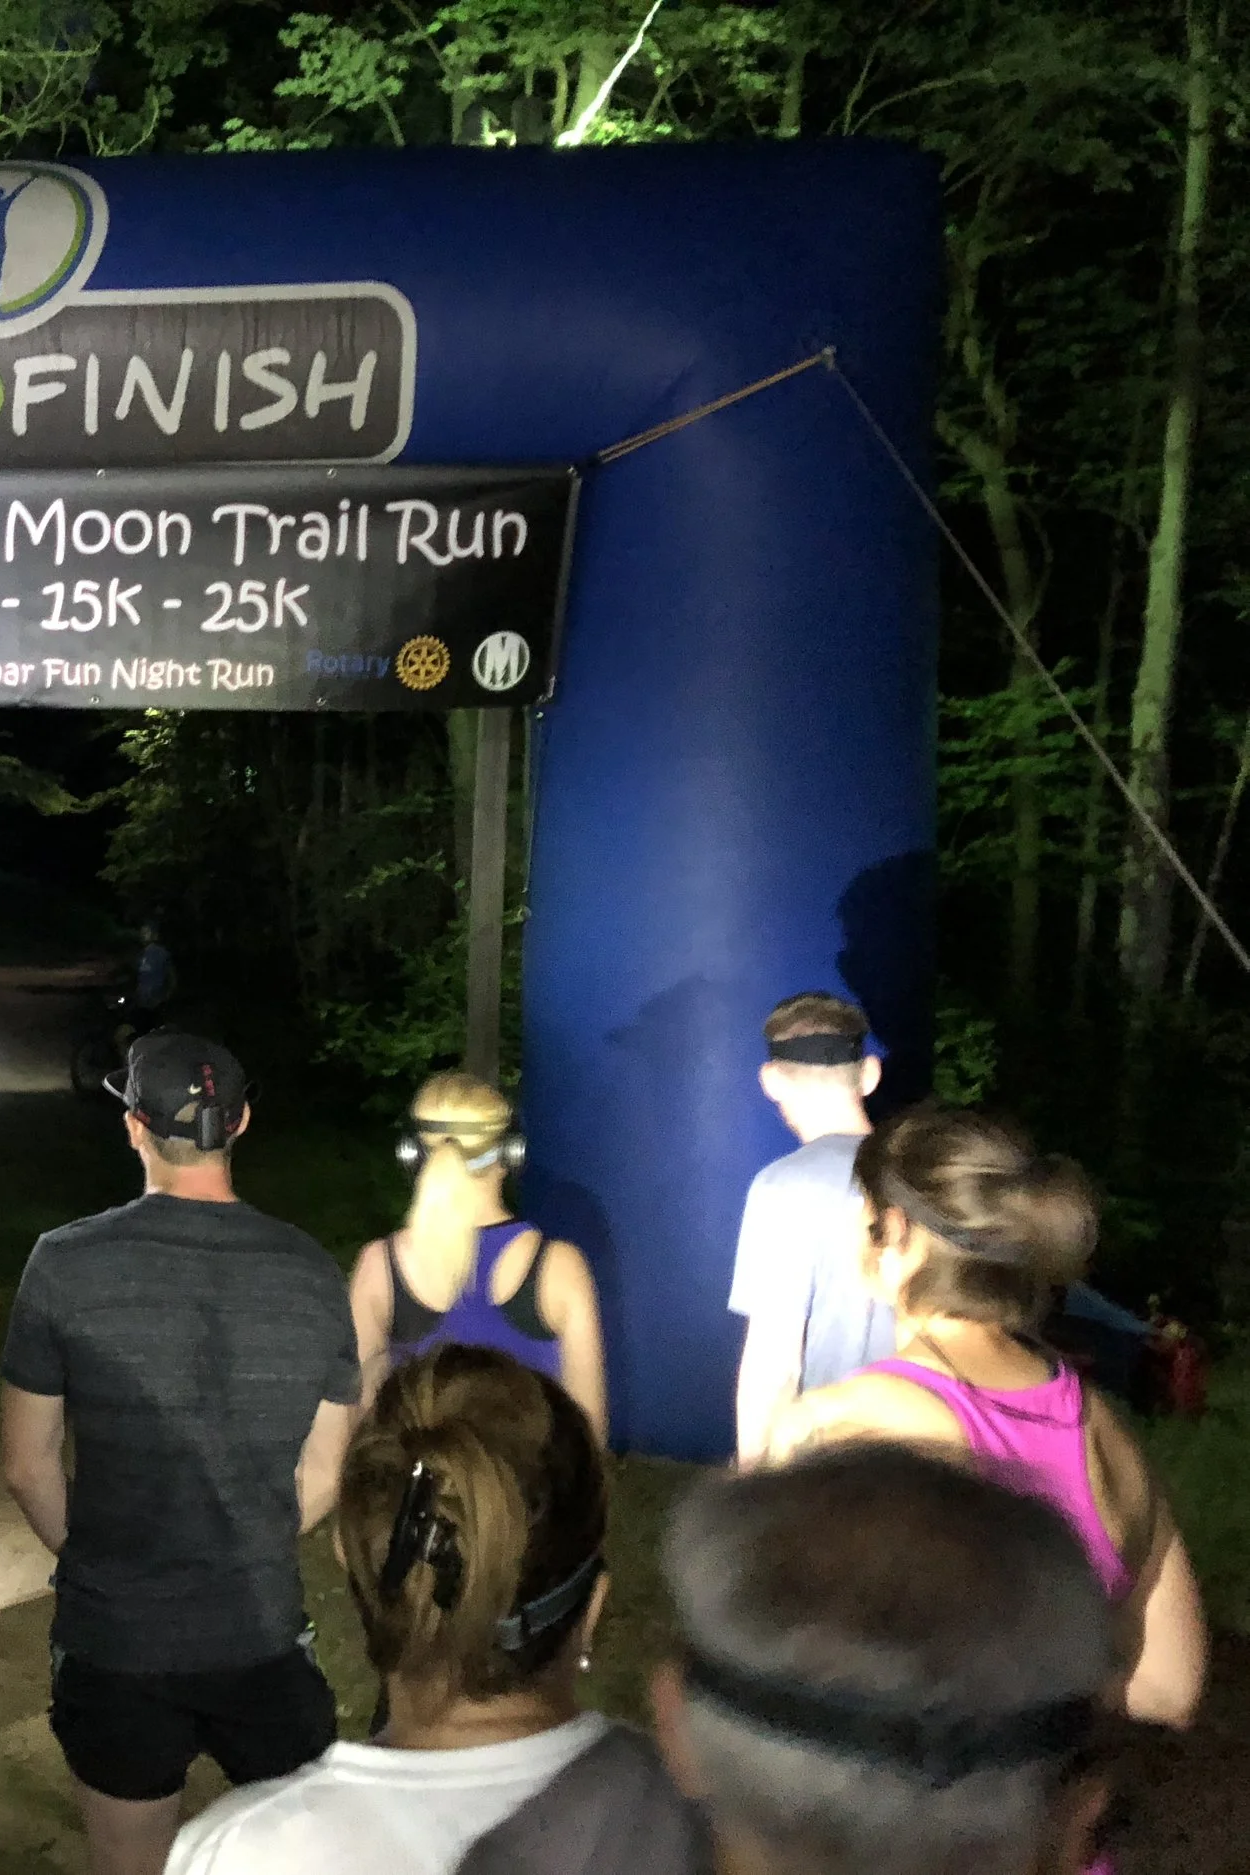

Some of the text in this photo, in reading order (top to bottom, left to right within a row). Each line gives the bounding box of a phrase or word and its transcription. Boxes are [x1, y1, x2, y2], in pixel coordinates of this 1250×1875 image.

[4, 498, 193, 566] Moon
[211, 498, 369, 567] Trail
[384, 499, 529, 567] Run
[40, 576, 143, 632] 15K
[200, 576, 311, 633] 25K
[40, 657, 101, 690] Fun
[109, 657, 202, 691] Night
[205, 657, 275, 692] Run
[306, 649, 392, 678] Rotary
